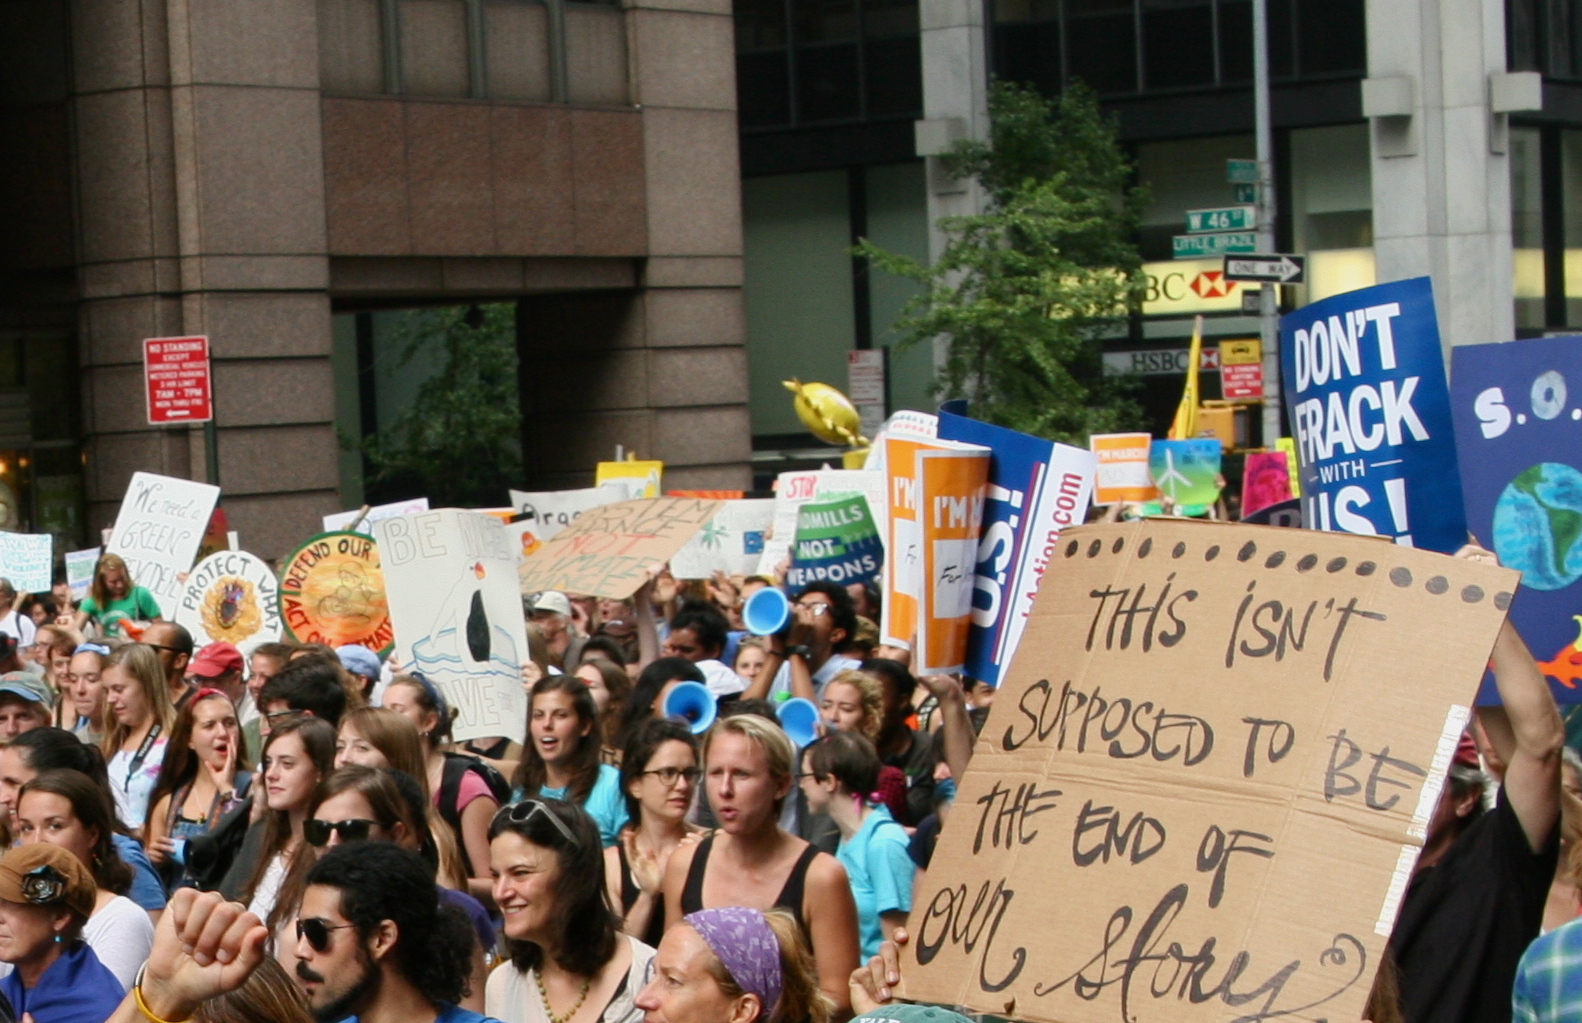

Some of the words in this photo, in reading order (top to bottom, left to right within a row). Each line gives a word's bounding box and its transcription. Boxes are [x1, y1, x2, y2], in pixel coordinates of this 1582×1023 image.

[1188, 215, 1201, 229] W
[1208, 213, 1230, 228] 46
[1174, 236, 1210, 250] LITTLE
[1214, 233, 1255, 248] BRAZIL
[1234, 261, 1258, 274] ONE
[1268, 262, 1292, 275] WAY
[1294, 302, 1400, 393] DON'T
[1294, 375, 1430, 468] FRACK
[1319, 459, 1366, 484] WITH
[933, 495, 967, 529] I'M
[119, 519, 191, 556] GREEN
[383, 512, 447, 566] BE
[554, 532, 657, 557] NOT
[799, 539, 835, 558] NOT
[284, 541, 331, 590] DEFEND
[337, 538, 373, 561] OUR
[788, 554, 876, 586] WEAPONS
[182, 554, 252, 611] PROTECT
[257, 573, 283, 634] WHAT
[284, 597, 311, 631] ACT
[1003, 678, 1215, 768] SUPPOSED
[1242, 714, 1296, 779] TO
[1324, 729, 1429, 812] BE
[972, 780, 1064, 856] THE
[1072, 799, 1167, 868] END
[1196, 823, 1277, 908] OF
